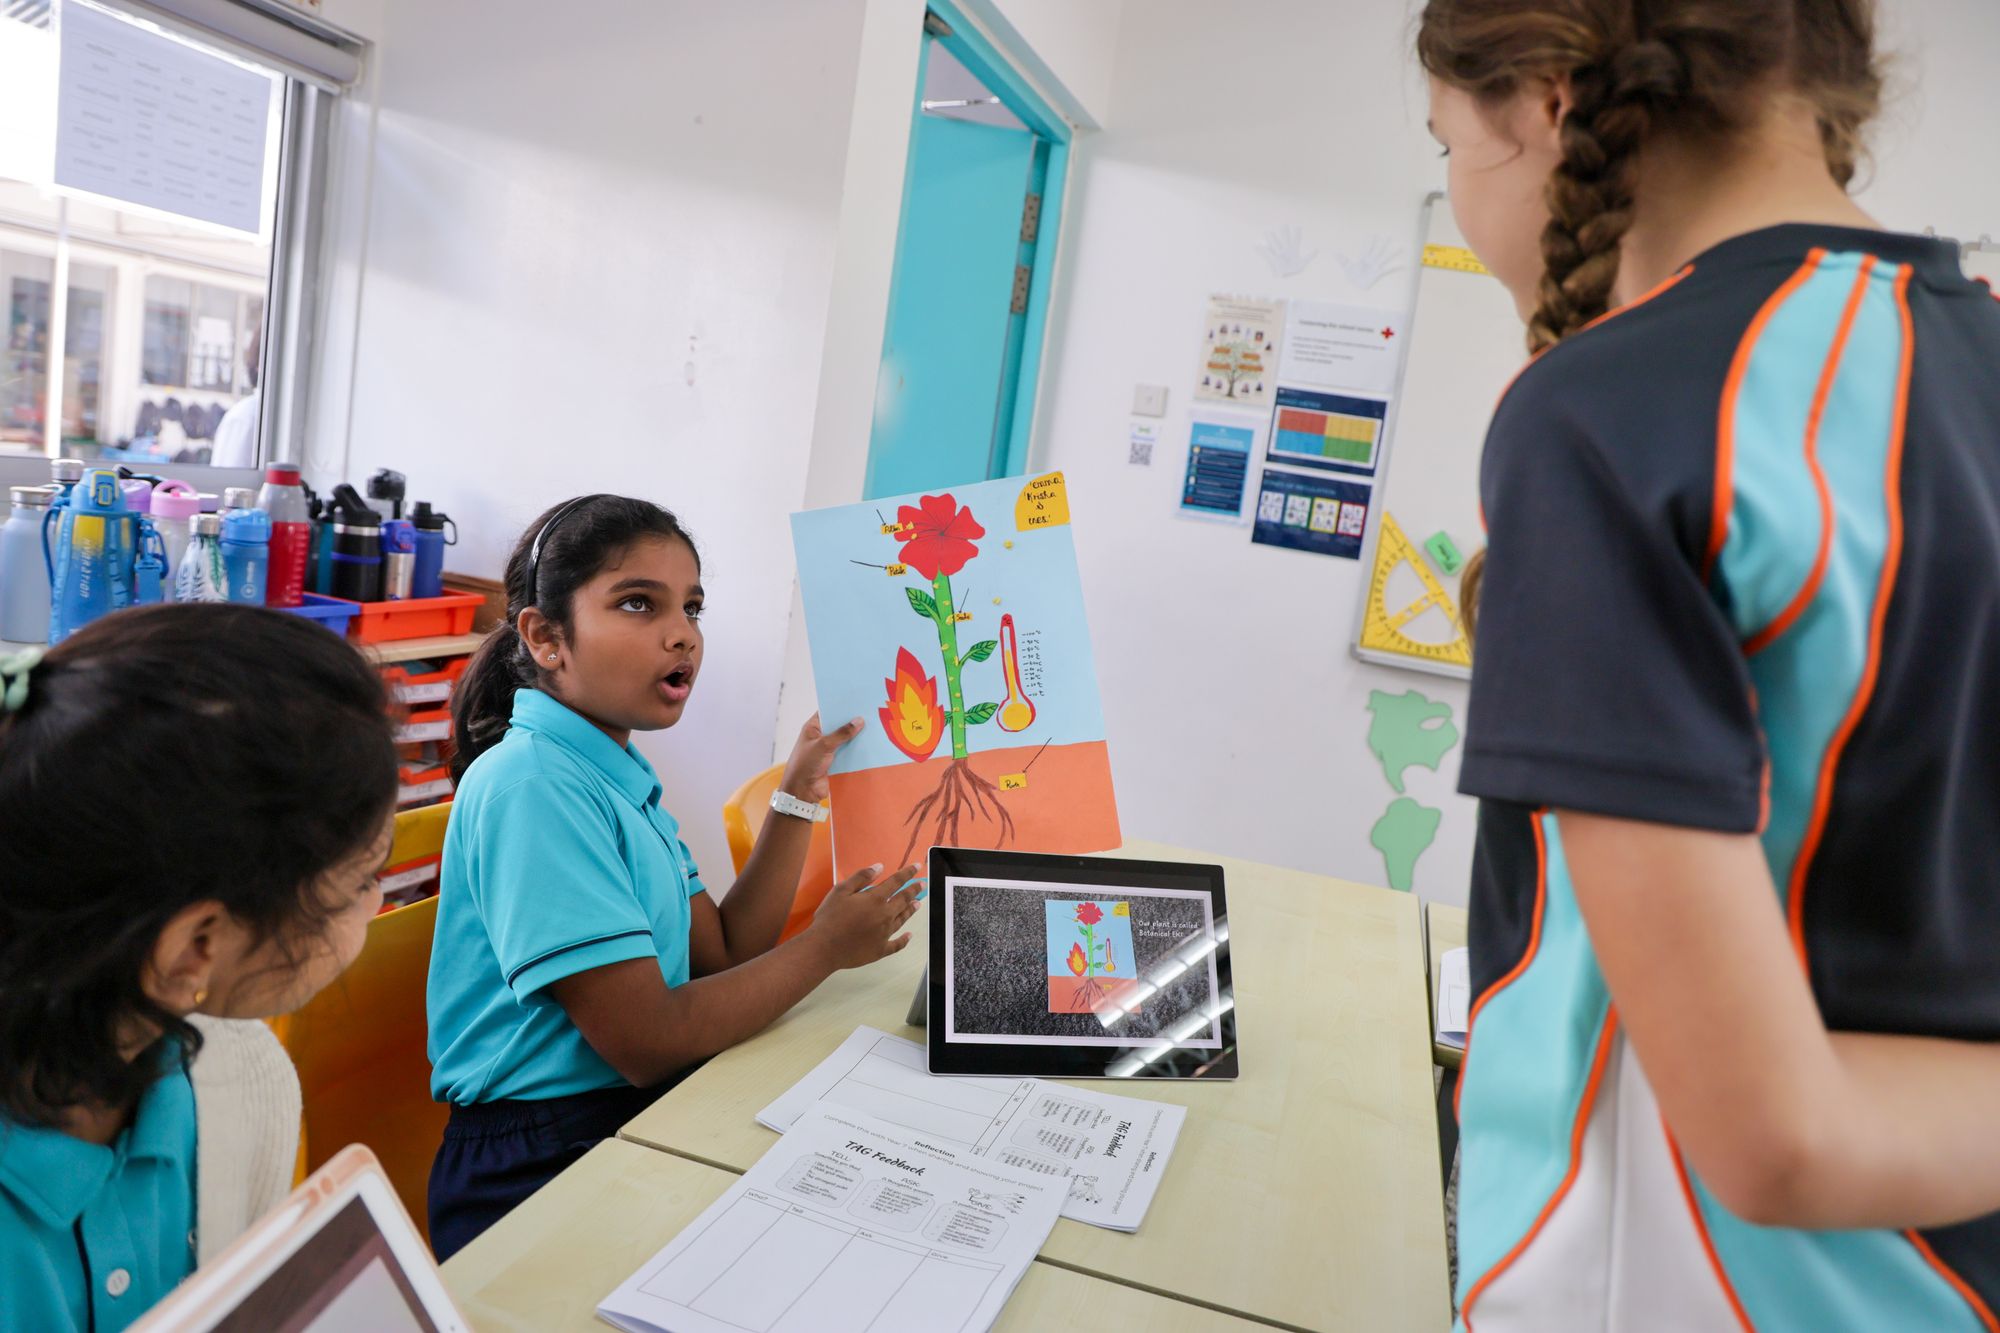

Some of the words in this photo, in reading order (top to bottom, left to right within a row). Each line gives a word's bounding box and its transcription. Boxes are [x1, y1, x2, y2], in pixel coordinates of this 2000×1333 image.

[1152, 919, 1170, 930] plant
[1139, 929, 1170, 937] Botanical
[1116, 1120, 1132, 1134] TAG
[914, 1141, 956, 1158] Reflection
[845, 1140, 873, 1155] TAG
[871, 1151, 926, 1176] Feedback
[928, 1152, 954, 1165] sharing
[955, 1163, 970, 1171] and
[970, 1167, 1001, 1181] showing
